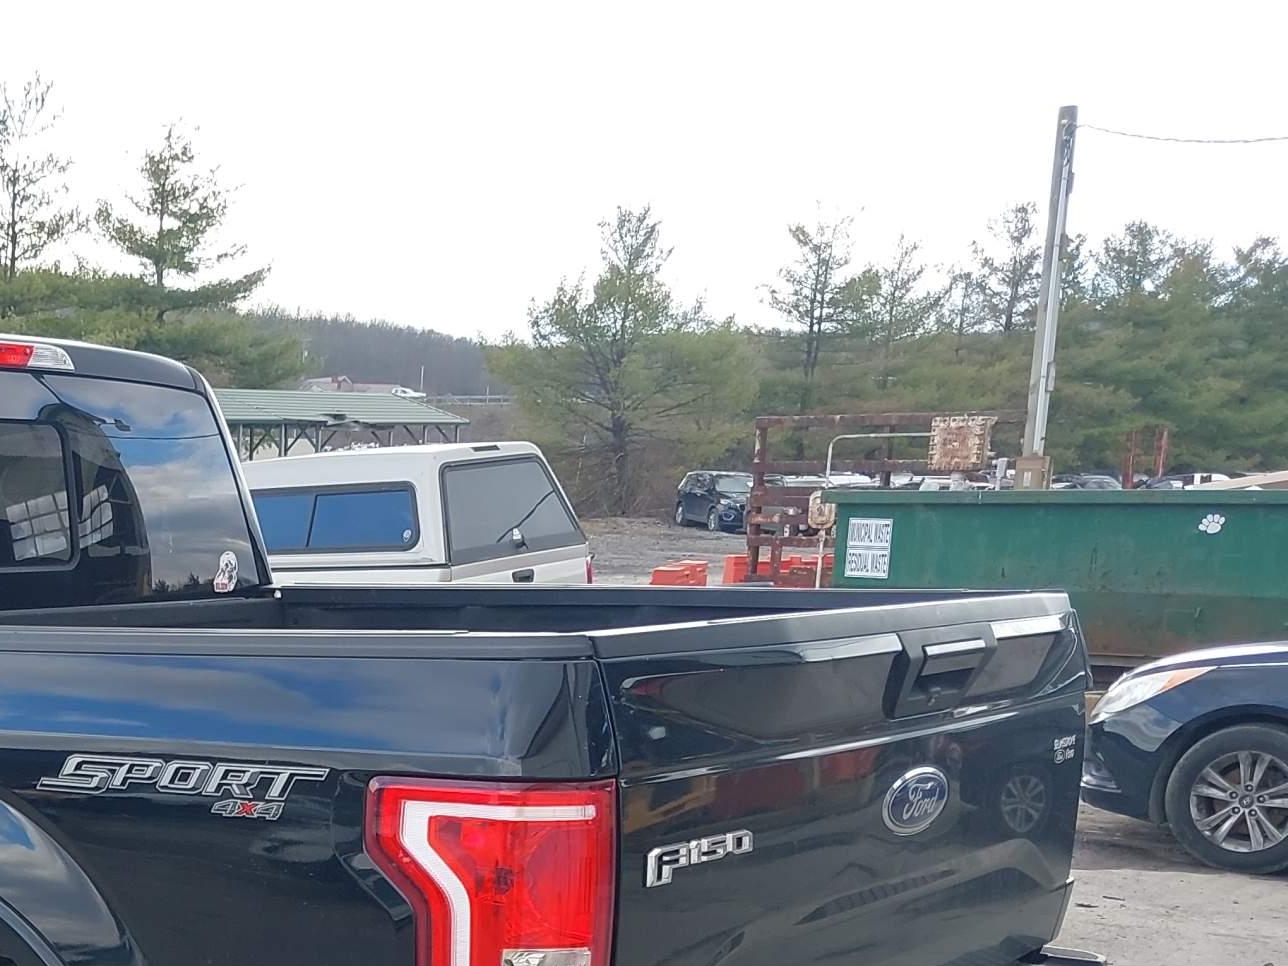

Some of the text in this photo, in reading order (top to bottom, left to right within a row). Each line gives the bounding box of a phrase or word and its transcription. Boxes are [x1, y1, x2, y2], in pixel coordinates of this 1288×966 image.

[850, 522, 890, 543] MUNICIPAL WASTE
[848, 552, 887, 573] RESIDUAL WASTE
[35, 753, 330, 801] SPORT
[902, 781, 940, 821] Ford
